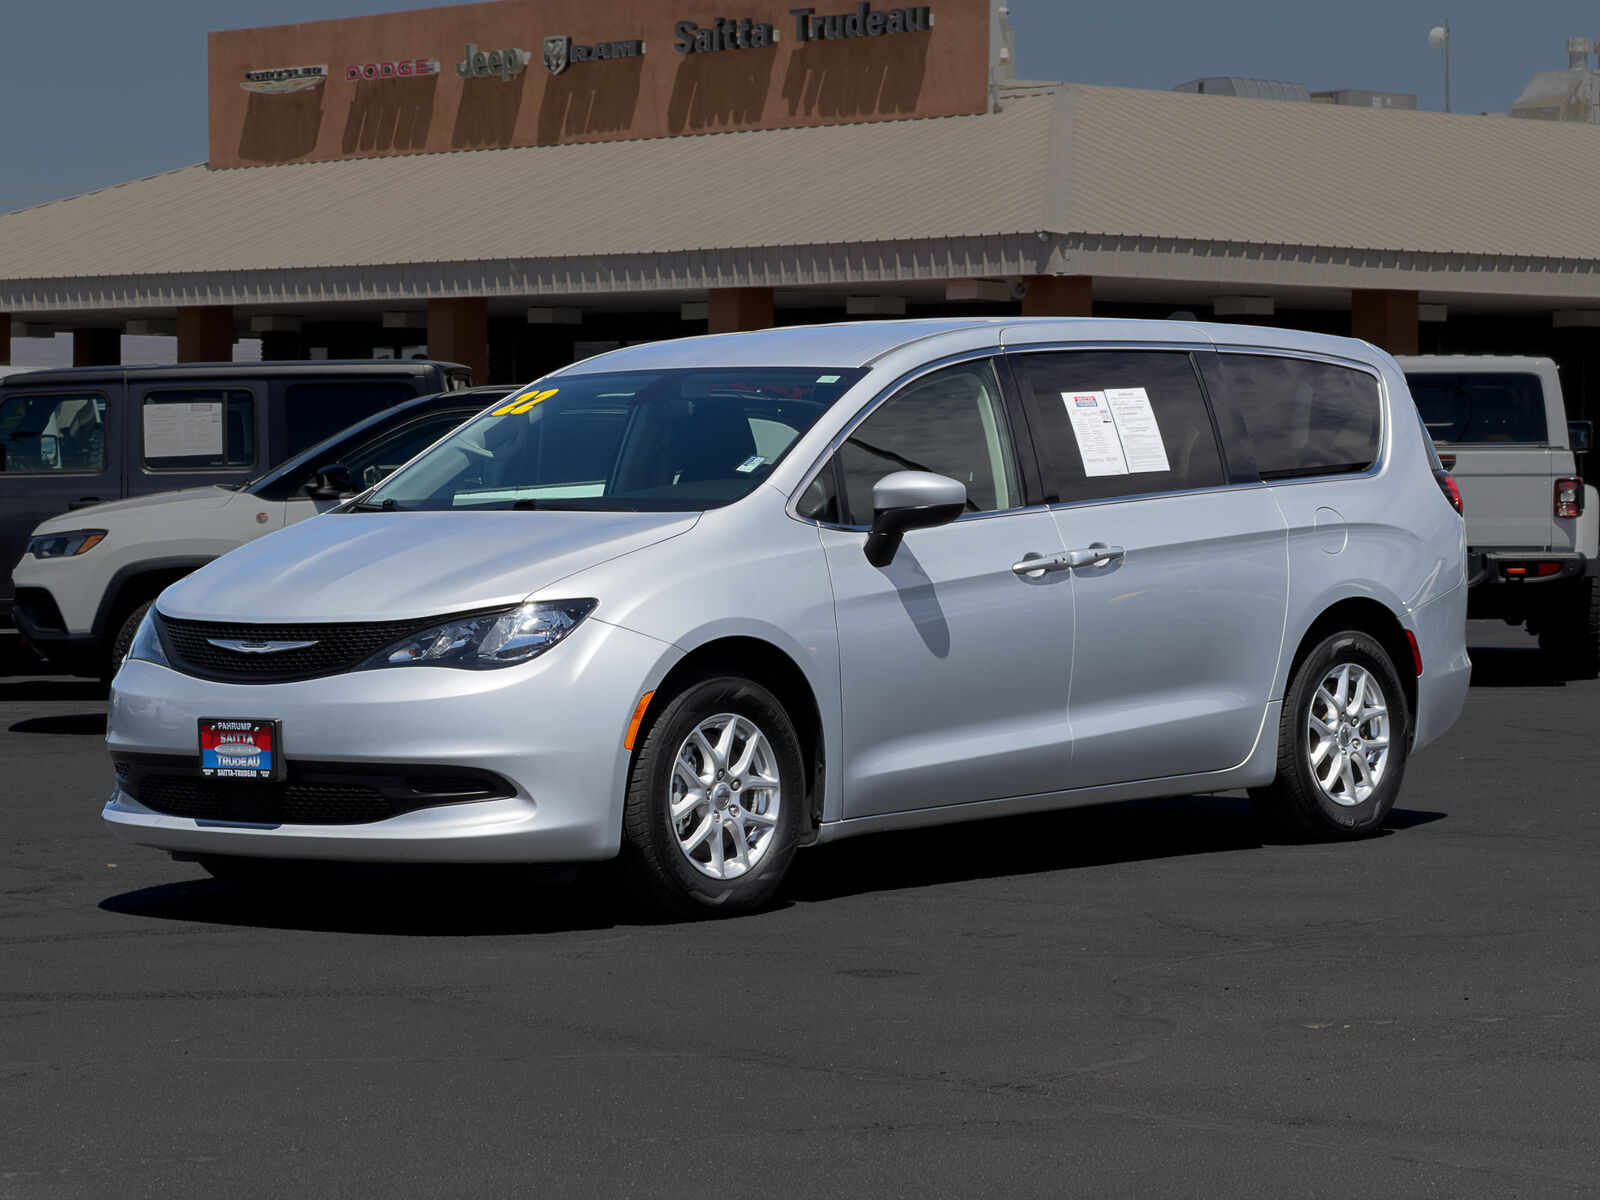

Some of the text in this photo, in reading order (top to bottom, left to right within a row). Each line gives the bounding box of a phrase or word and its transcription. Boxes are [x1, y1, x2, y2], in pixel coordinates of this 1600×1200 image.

[674, 2, 931, 55] Saitta Trudeau
[456, 43, 526, 82] Jeep
[570, 41, 643, 62] RAM
[345, 59, 437, 82] DODGE
[490, 388, 559, 416] 22
[217, 722, 252, 731] PAHRUMP
[220, 733, 255, 744] SAITTA
[216, 755, 261, 768] TRUDEAU
